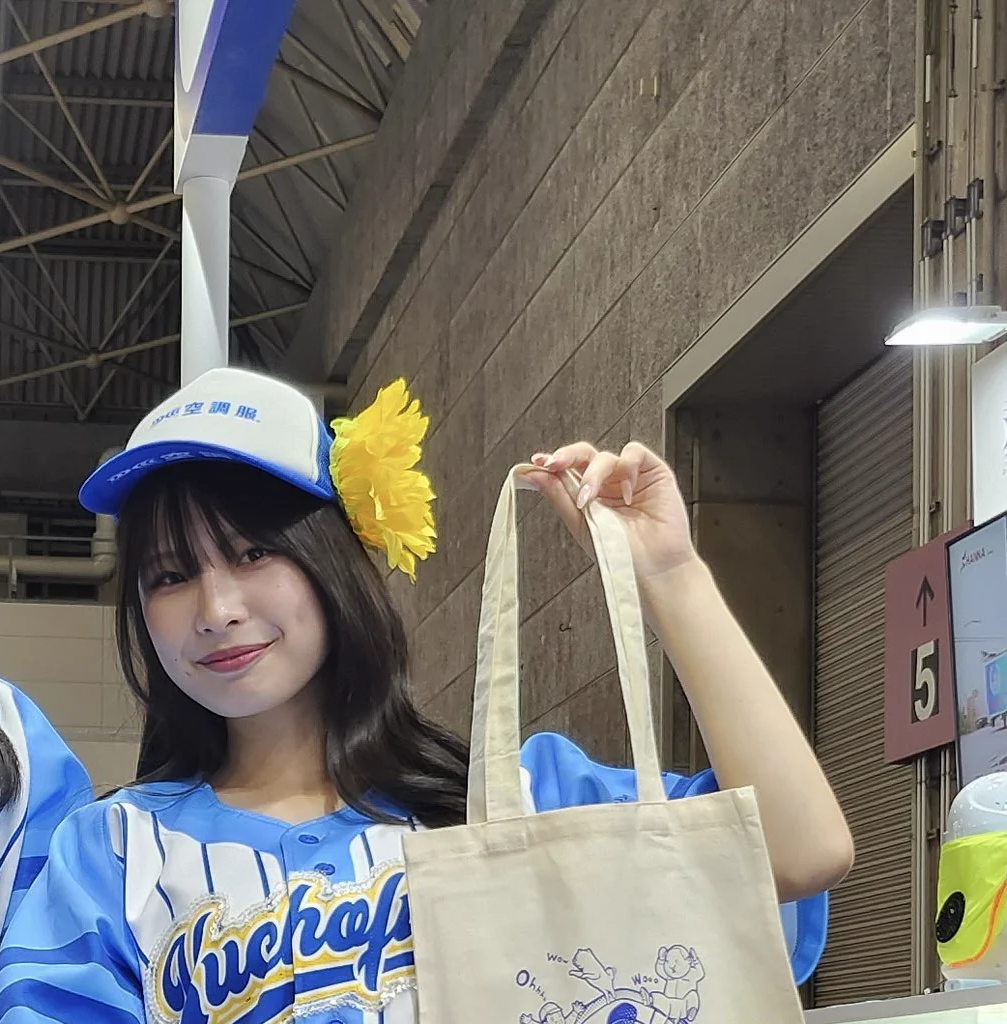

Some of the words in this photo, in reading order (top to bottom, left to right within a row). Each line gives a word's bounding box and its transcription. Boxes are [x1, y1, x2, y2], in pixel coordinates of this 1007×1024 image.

[184, 400, 259, 422] 空調服
[913, 642, 936, 722] 5
